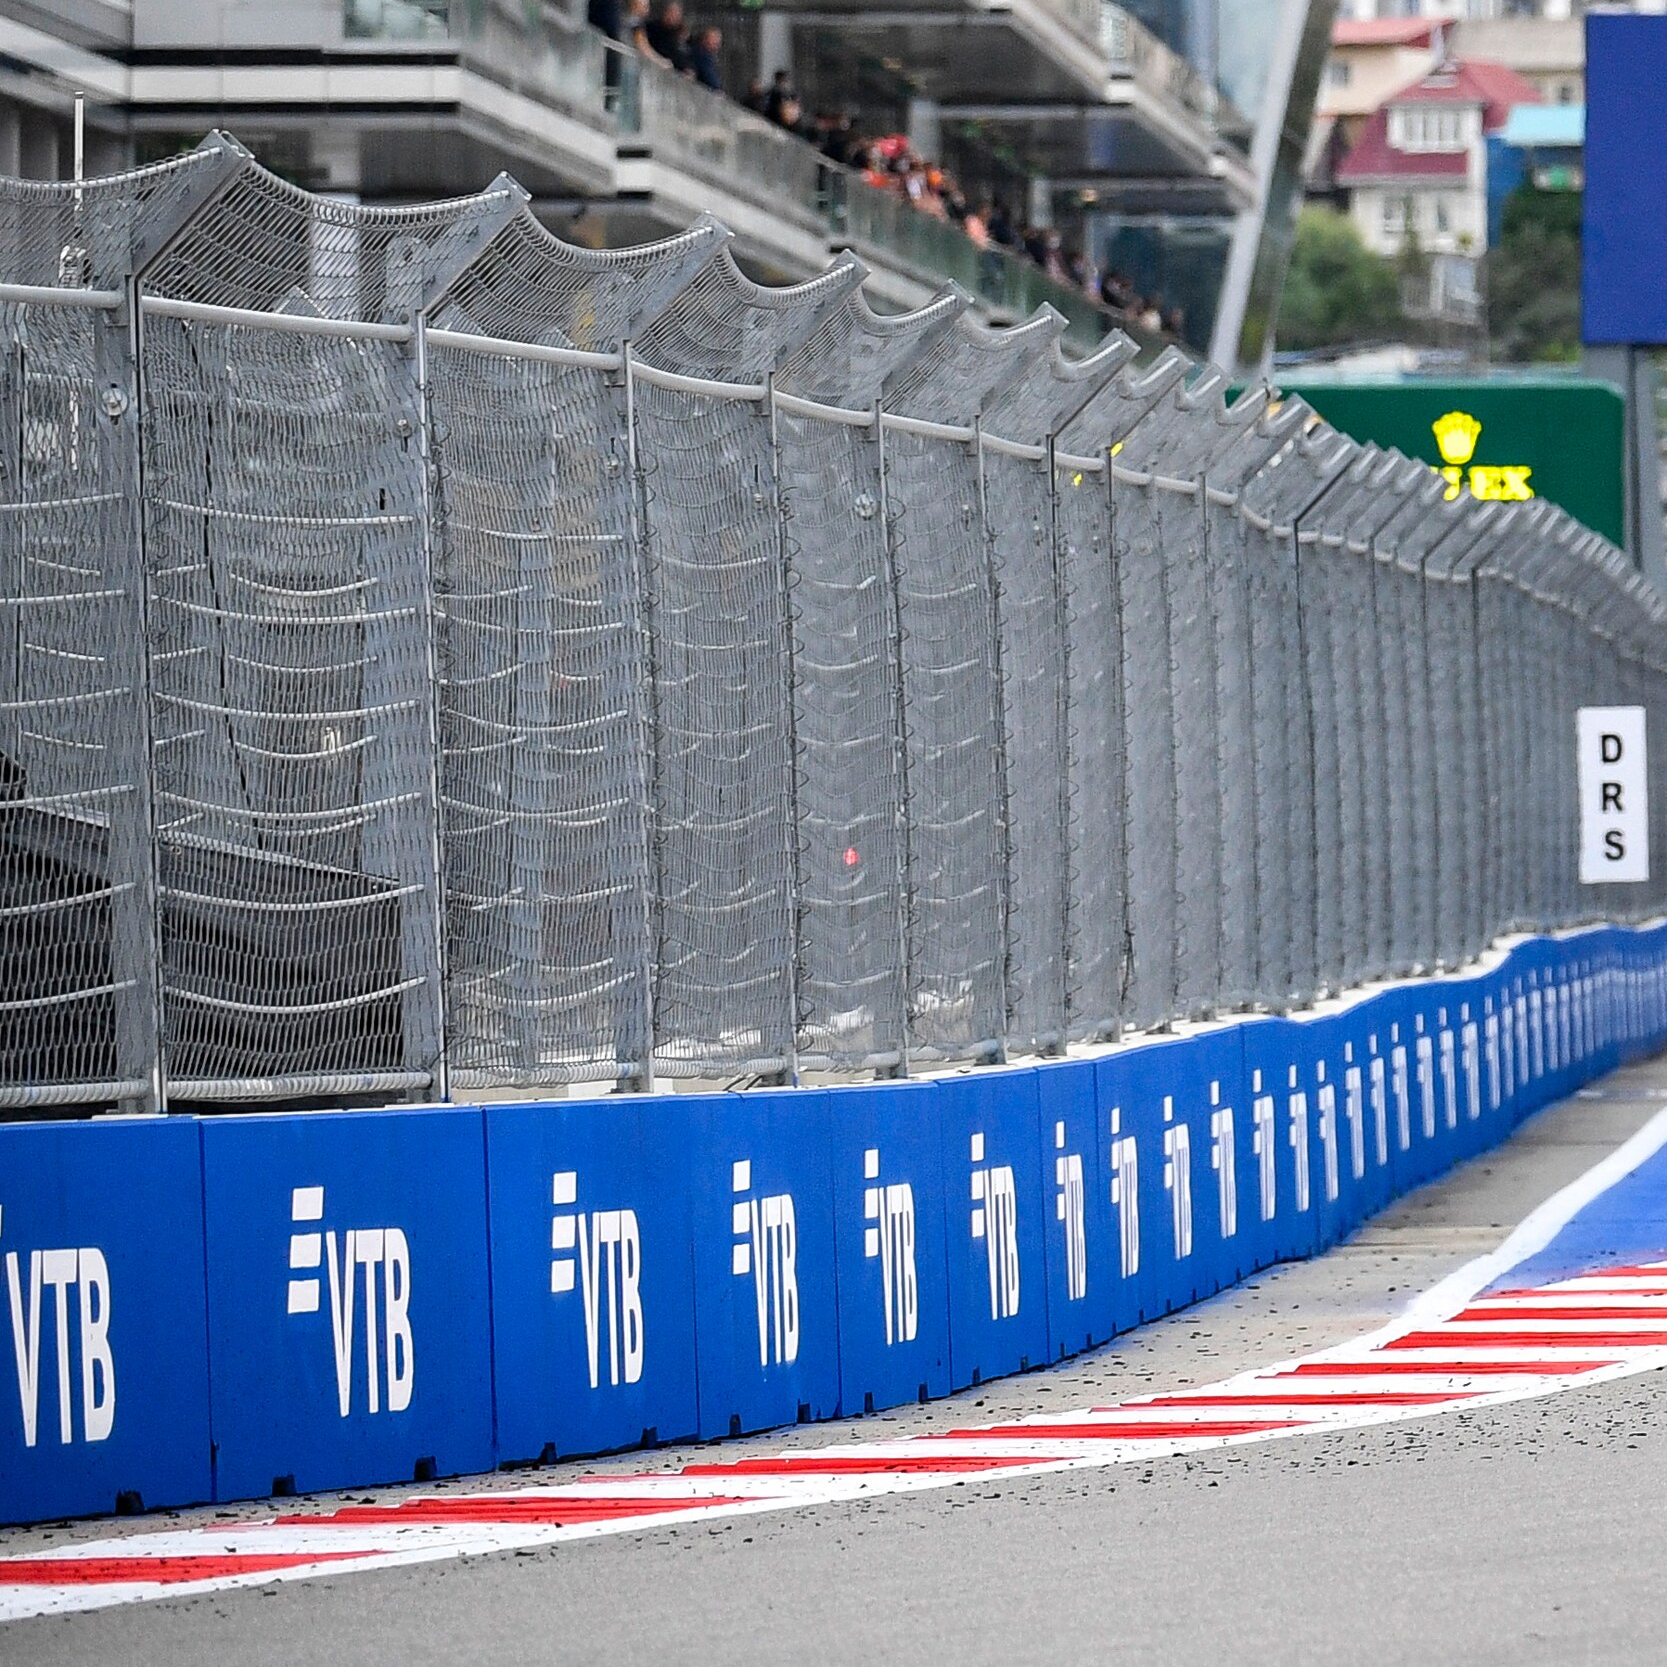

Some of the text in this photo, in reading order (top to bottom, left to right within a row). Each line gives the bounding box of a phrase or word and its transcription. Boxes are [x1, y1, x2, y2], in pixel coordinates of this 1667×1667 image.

[1601, 734, 1625, 861] DRS
[325, 1227, 414, 1417] VTB
[578, 1209, 644, 1389] VTB
[750, 1193, 800, 1366] VTB
[878, 1182, 918, 1345] VTB
[982, 1165, 1020, 1320] VTB
[6, 1247, 116, 1447] VTB
